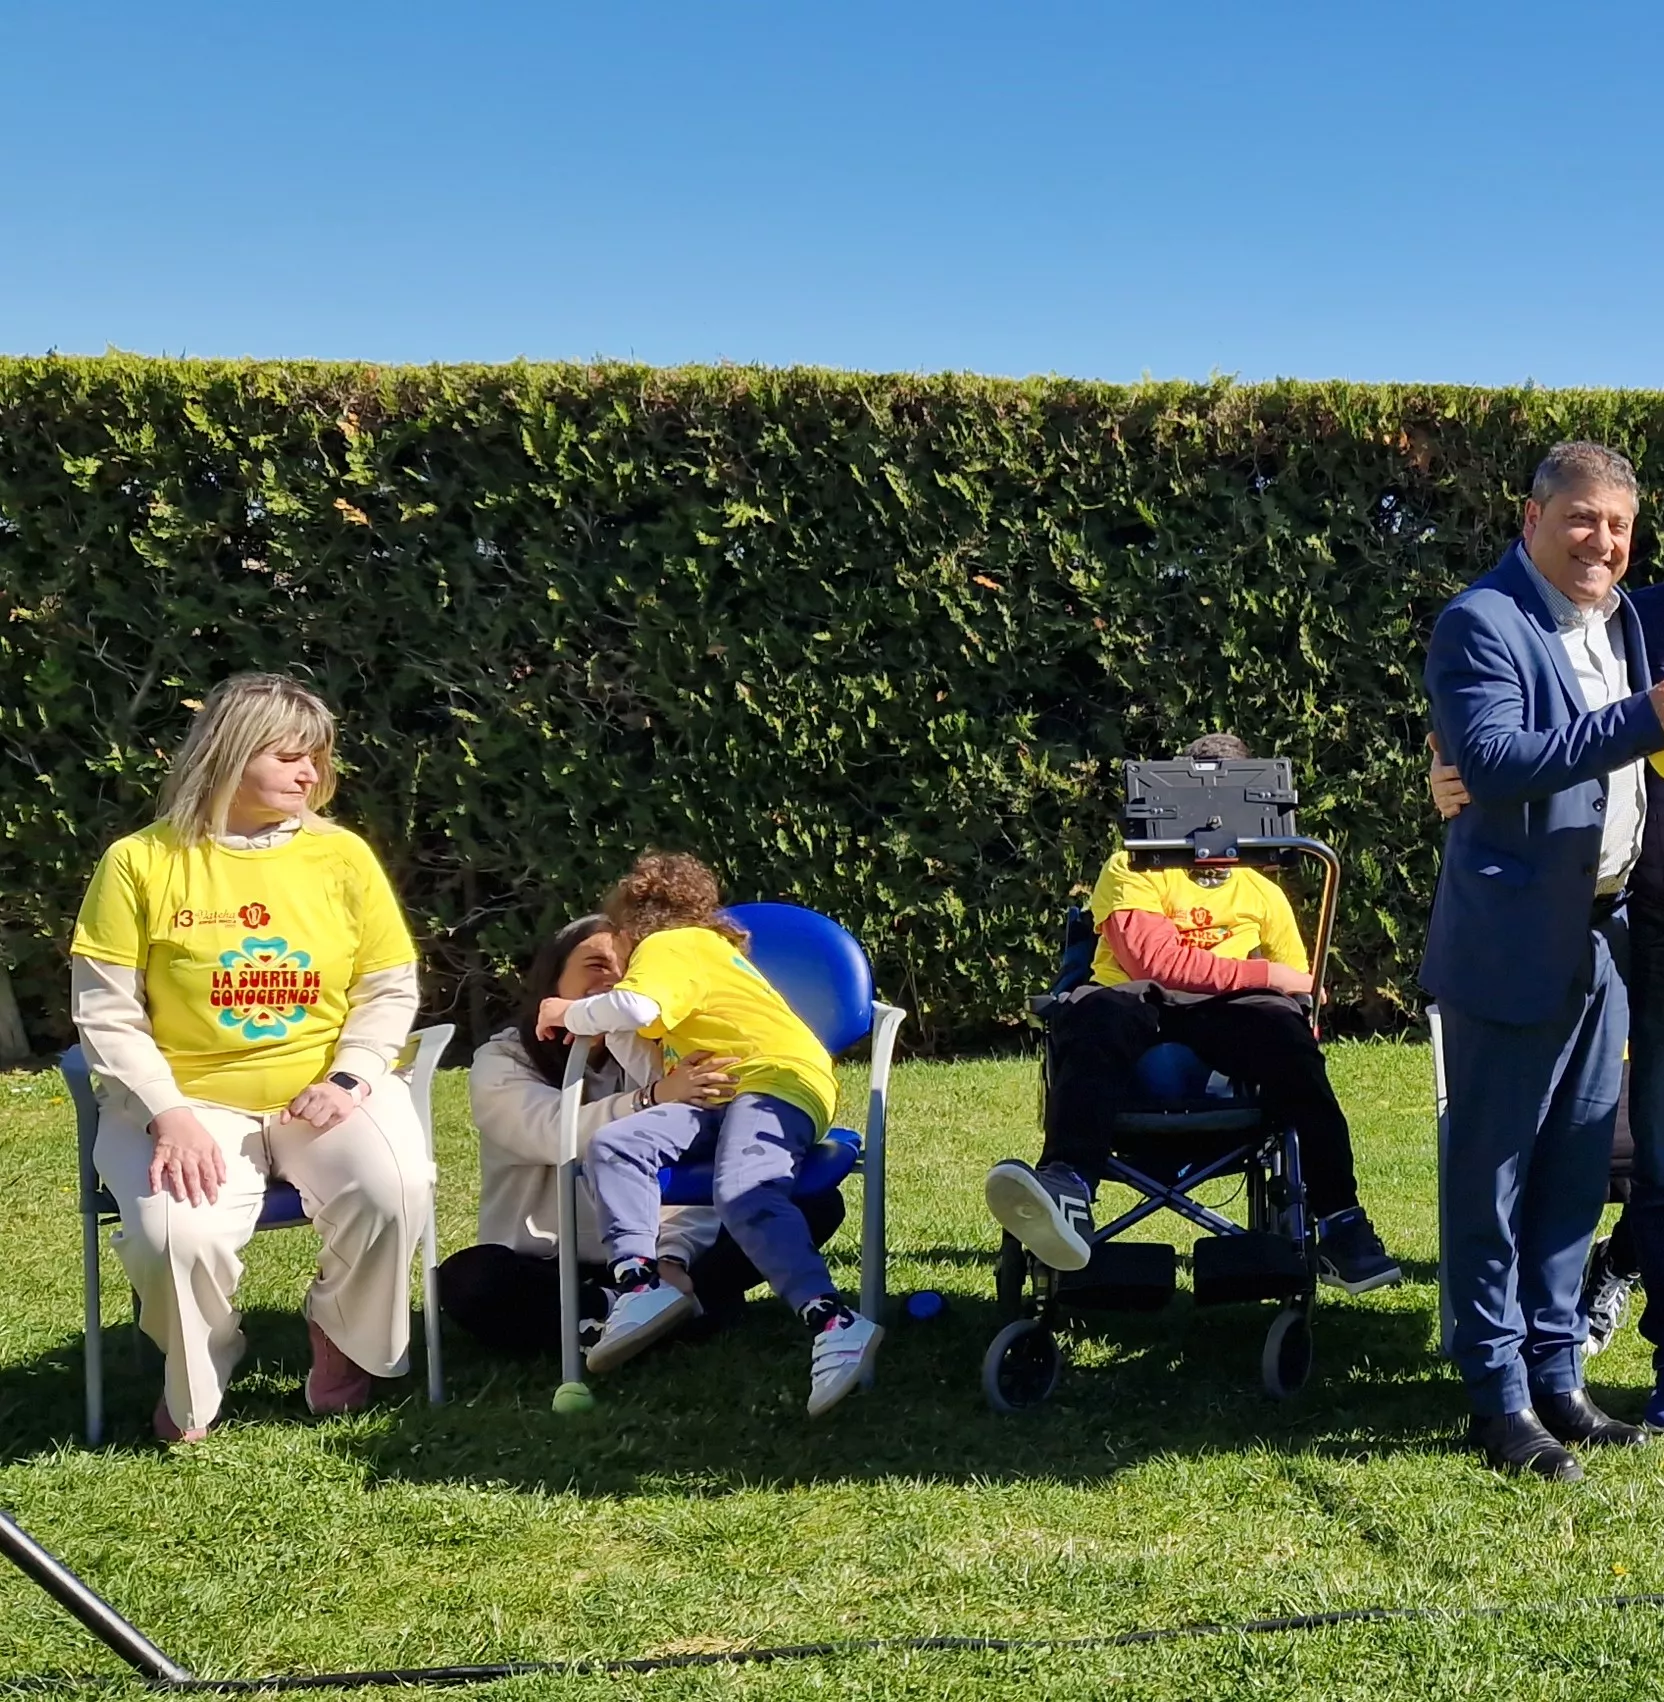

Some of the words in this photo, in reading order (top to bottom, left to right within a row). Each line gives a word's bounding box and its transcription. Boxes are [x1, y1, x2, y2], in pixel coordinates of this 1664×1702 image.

[172, 910, 193, 928] 13
[212, 971, 233, 989] LA
[239, 971, 298, 989] SUERTE
[303, 971, 321, 988] DE
[210, 989, 320, 1006] CONOCERNOS
